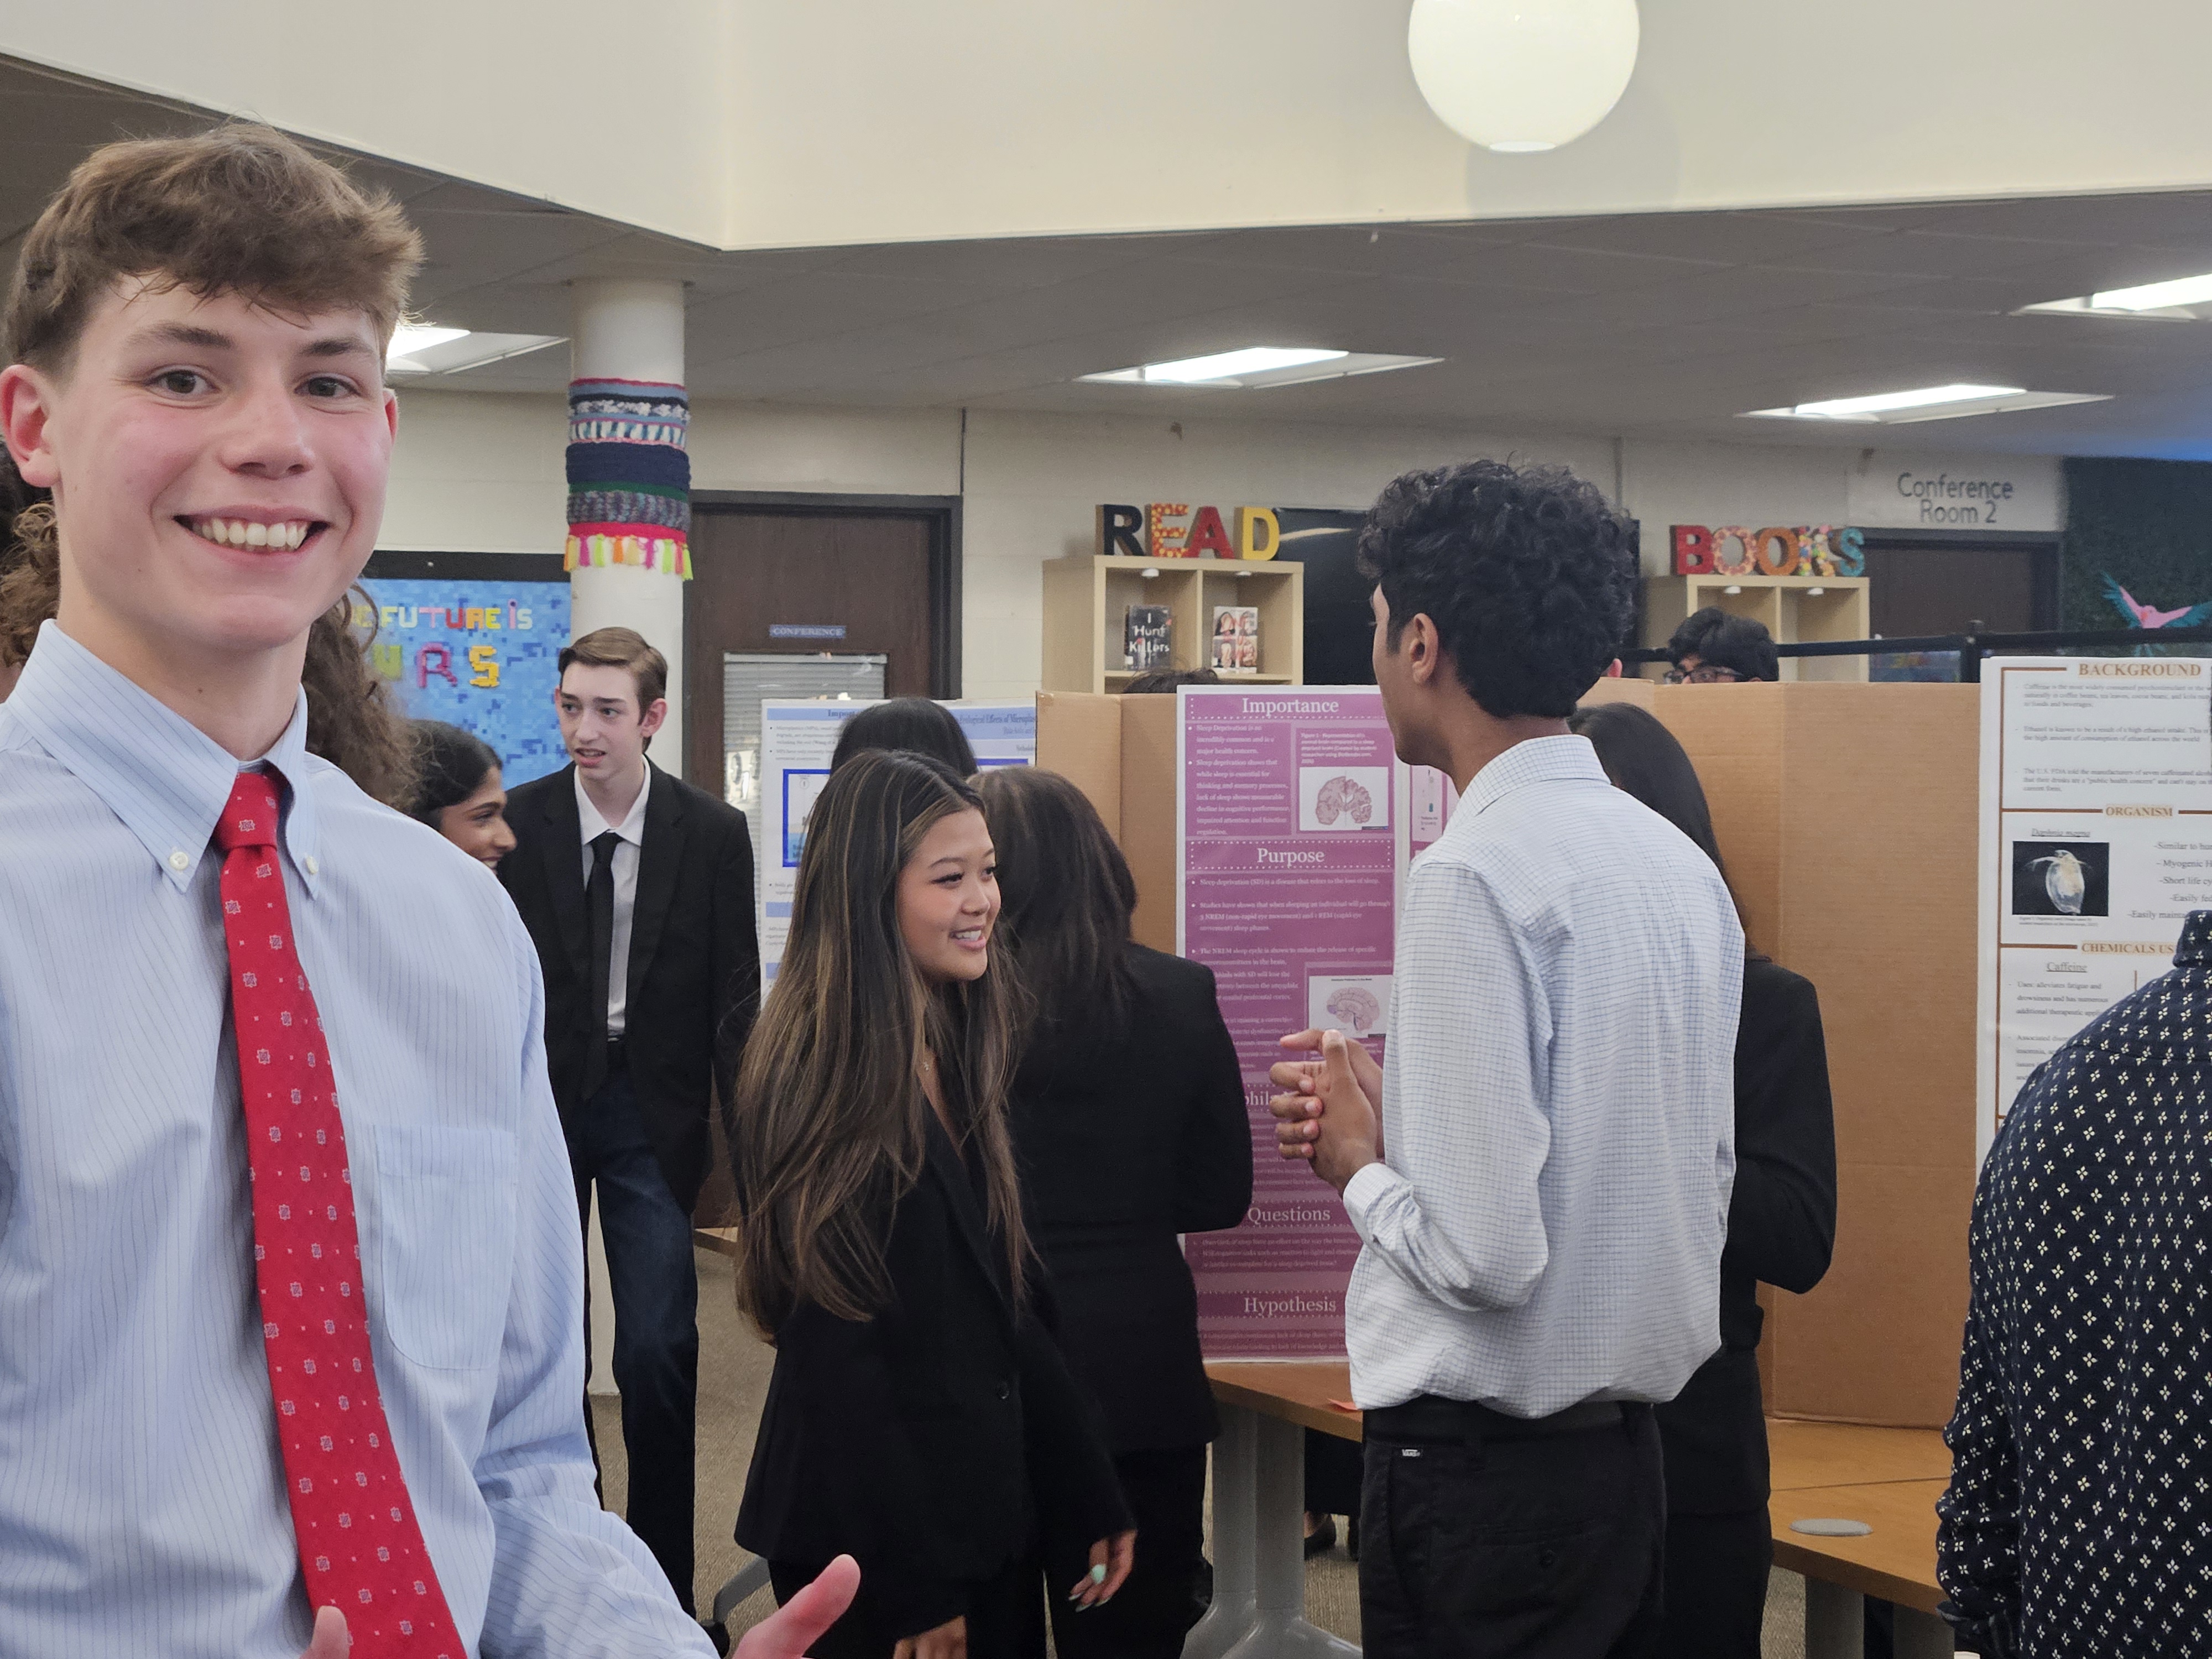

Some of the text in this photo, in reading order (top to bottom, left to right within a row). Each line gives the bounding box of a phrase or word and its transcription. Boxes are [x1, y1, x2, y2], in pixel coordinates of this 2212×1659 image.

[1897, 472, 2013, 499] Conference
[1920, 499, 1996, 523] Room 2
[1096, 503, 1280, 561] READ
[1670, 525, 1865, 577] BOOKS
[381, 606, 501, 629] FUTURE
[1147, 613, 1151, 624] I
[774, 628, 843, 636] CONFERENCE
[1132, 624, 1167, 636] Hunt
[371, 641, 500, 688] URS
[2078, 664, 2201, 677] BACKGROUND
[1242, 697, 1339, 717] Importance
[2106, 807, 2173, 816] ORGANISM
[1257, 848, 1325, 868] Purpose
[2163, 859, 2203, 869] Myogenic
[2081, 943, 2175, 953] CHEMICALS US
[2047, 962, 2087, 971] Caffeine
[1248, 1206, 1331, 1225] Questions
[1244, 1296, 1337, 1316] Hypothesis
